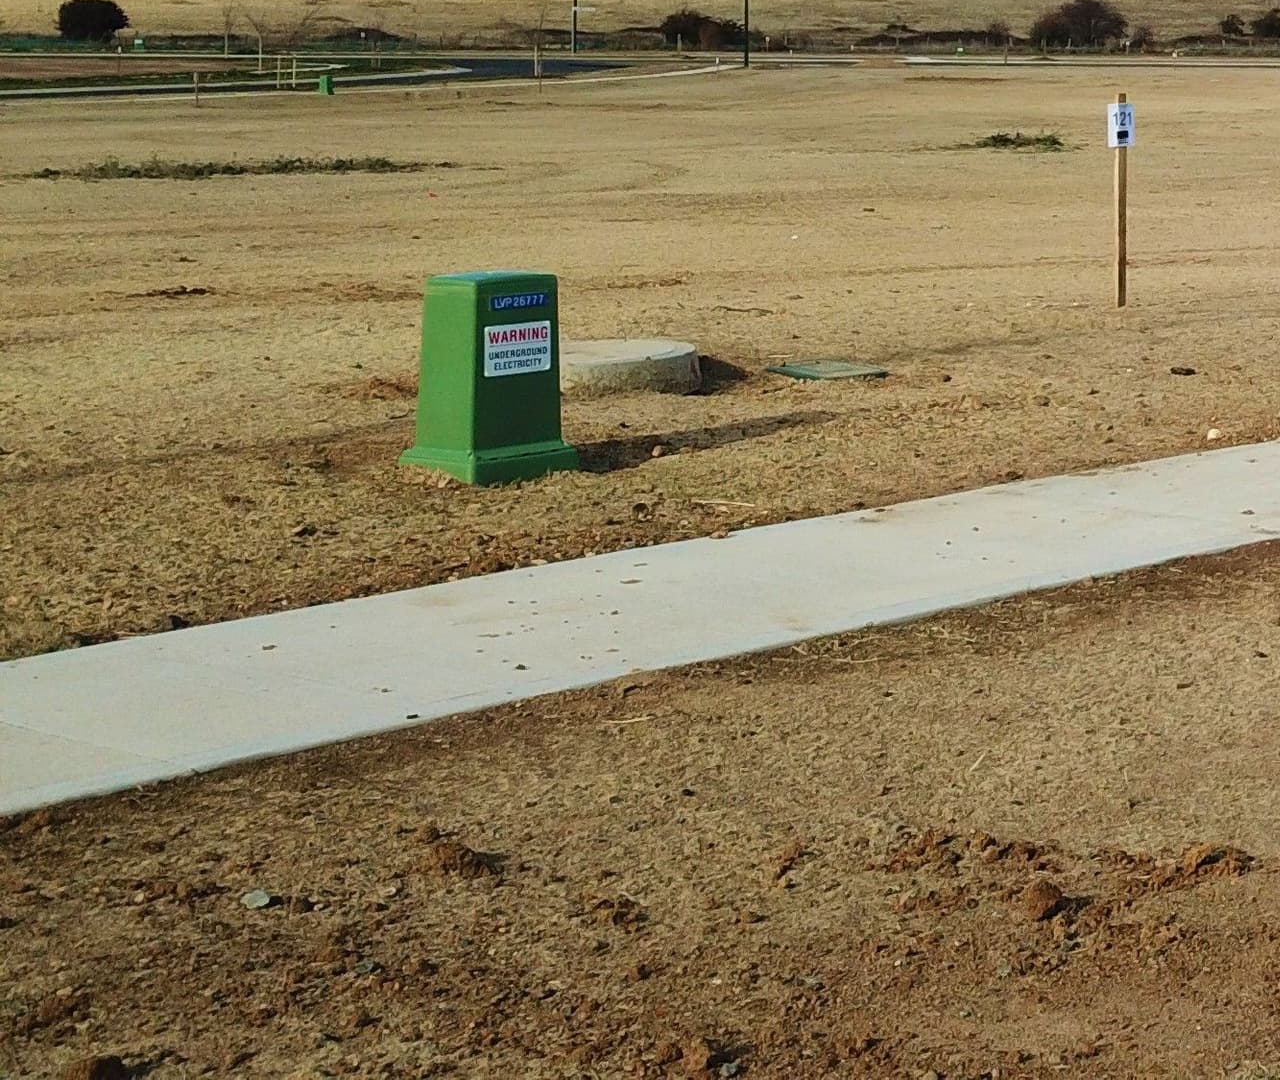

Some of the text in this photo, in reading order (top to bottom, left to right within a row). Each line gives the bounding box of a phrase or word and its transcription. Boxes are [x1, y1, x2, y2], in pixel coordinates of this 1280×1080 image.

[1113, 111, 1132, 126] 121
[488, 326, 548, 344] WARNING
[488, 346, 547, 361] UNDERGROUND
[494, 358, 542, 371] ELECTRICITY
